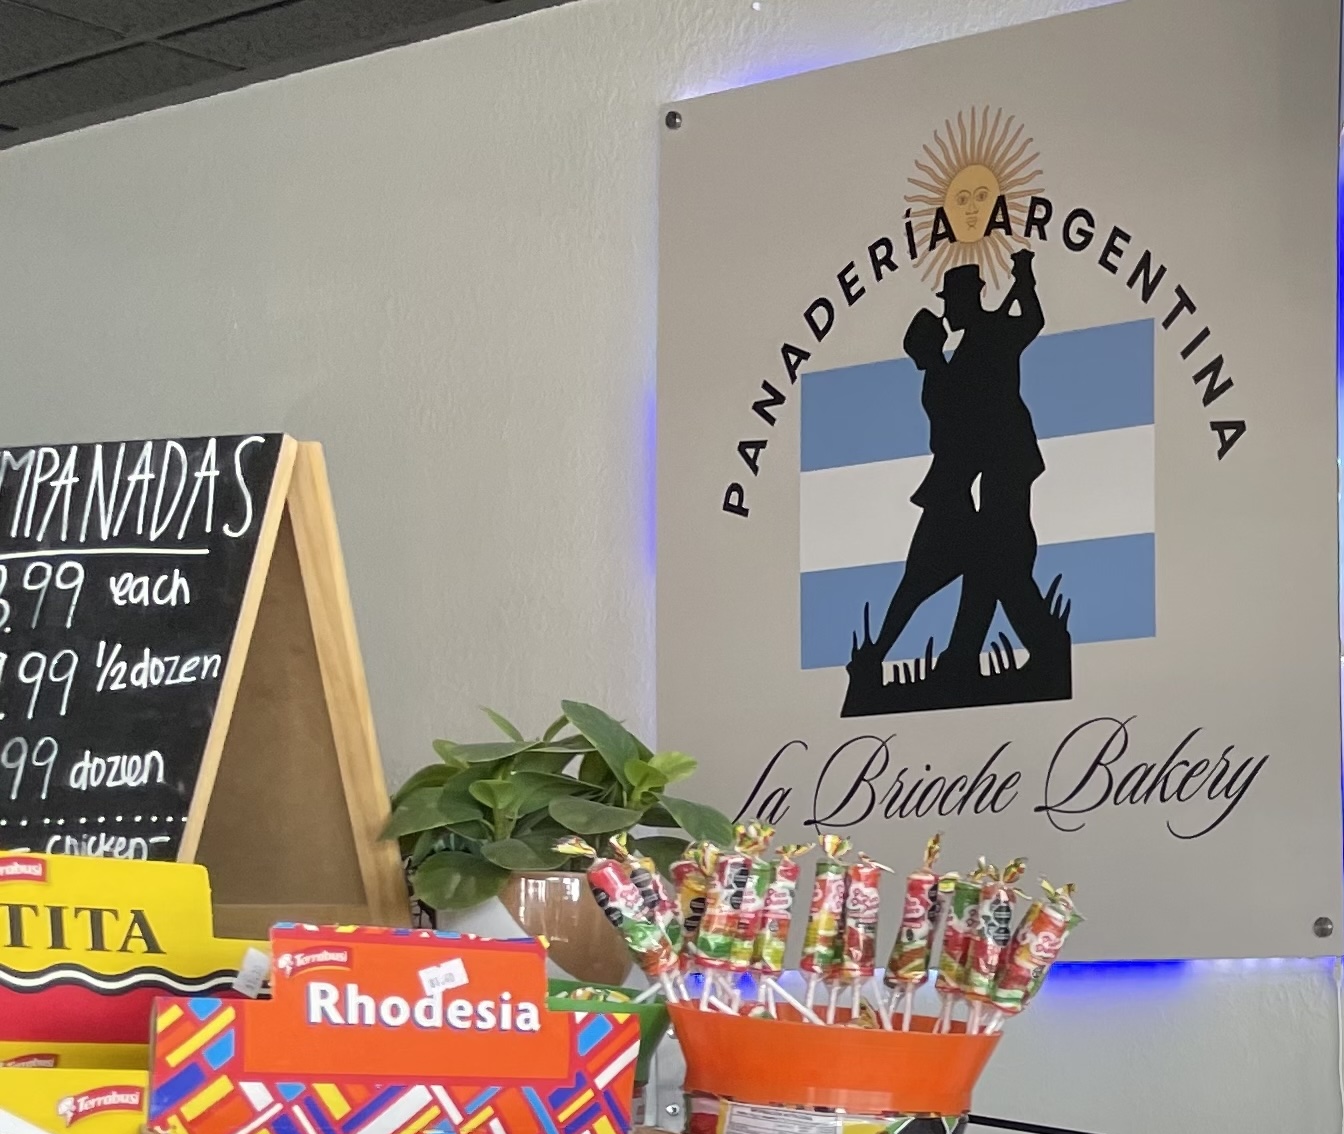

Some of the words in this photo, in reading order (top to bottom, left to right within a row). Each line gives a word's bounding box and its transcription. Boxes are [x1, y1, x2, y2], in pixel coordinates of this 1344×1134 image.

[722, 204, 954, 518] PANADERÍA
[983, 195, 1247, 462] ARGENTINA
[110, 568, 191, 607] each
[130, 647, 223, 690] dozen
[70, 750, 165, 791] dozen
[805, 734, 1022, 834] Brioche
[1035, 714, 1269, 839] Bakery
[46, 833, 149, 862] chicken
[0, 903, 167, 954] TITA
[295, 949, 349, 967] Terrabusi
[306, 981, 542, 1034] Rhodesia
[77, 1090, 140, 1113] Terrabusi
